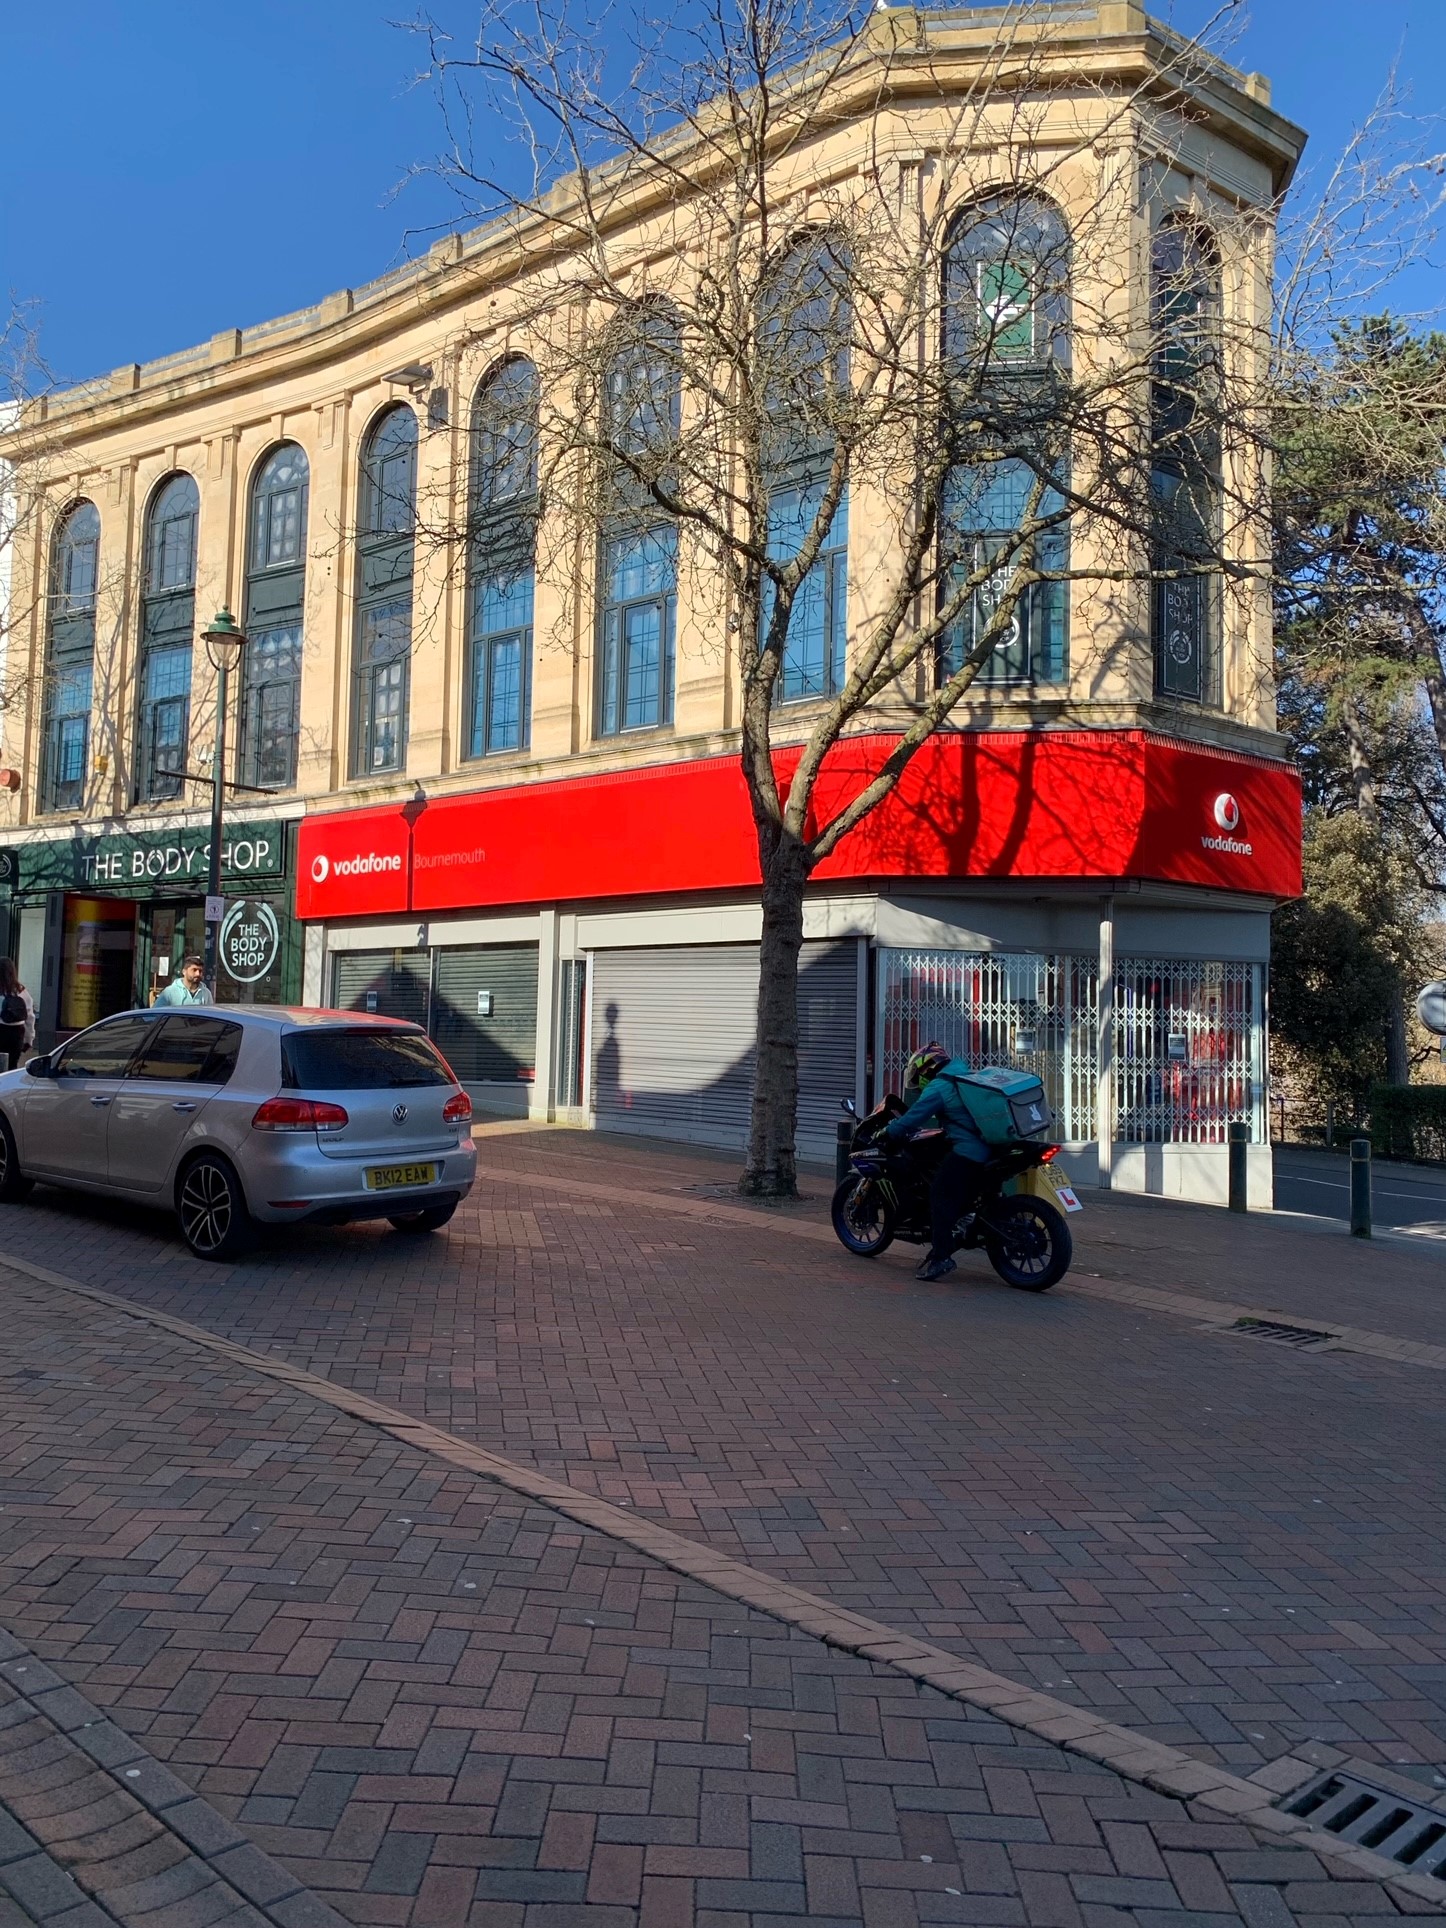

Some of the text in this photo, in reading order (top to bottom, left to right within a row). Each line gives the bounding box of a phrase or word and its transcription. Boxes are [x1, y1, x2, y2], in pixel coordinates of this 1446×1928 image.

[991, 565, 1017, 577] HE
[1200, 836, 1252, 856] vodafone
[82, 852, 123, 880] THE
[132, 846, 197, 877] BODY
[333, 847, 486, 876] vodafone Bournemouth
[238, 923, 259, 936] THE
[230, 936, 267, 952] BODY
[231, 952, 265, 966] SHOP
[374, 1166, 428, 1186] BK12 EAW
[1060, 1191, 1076, 1207] L
